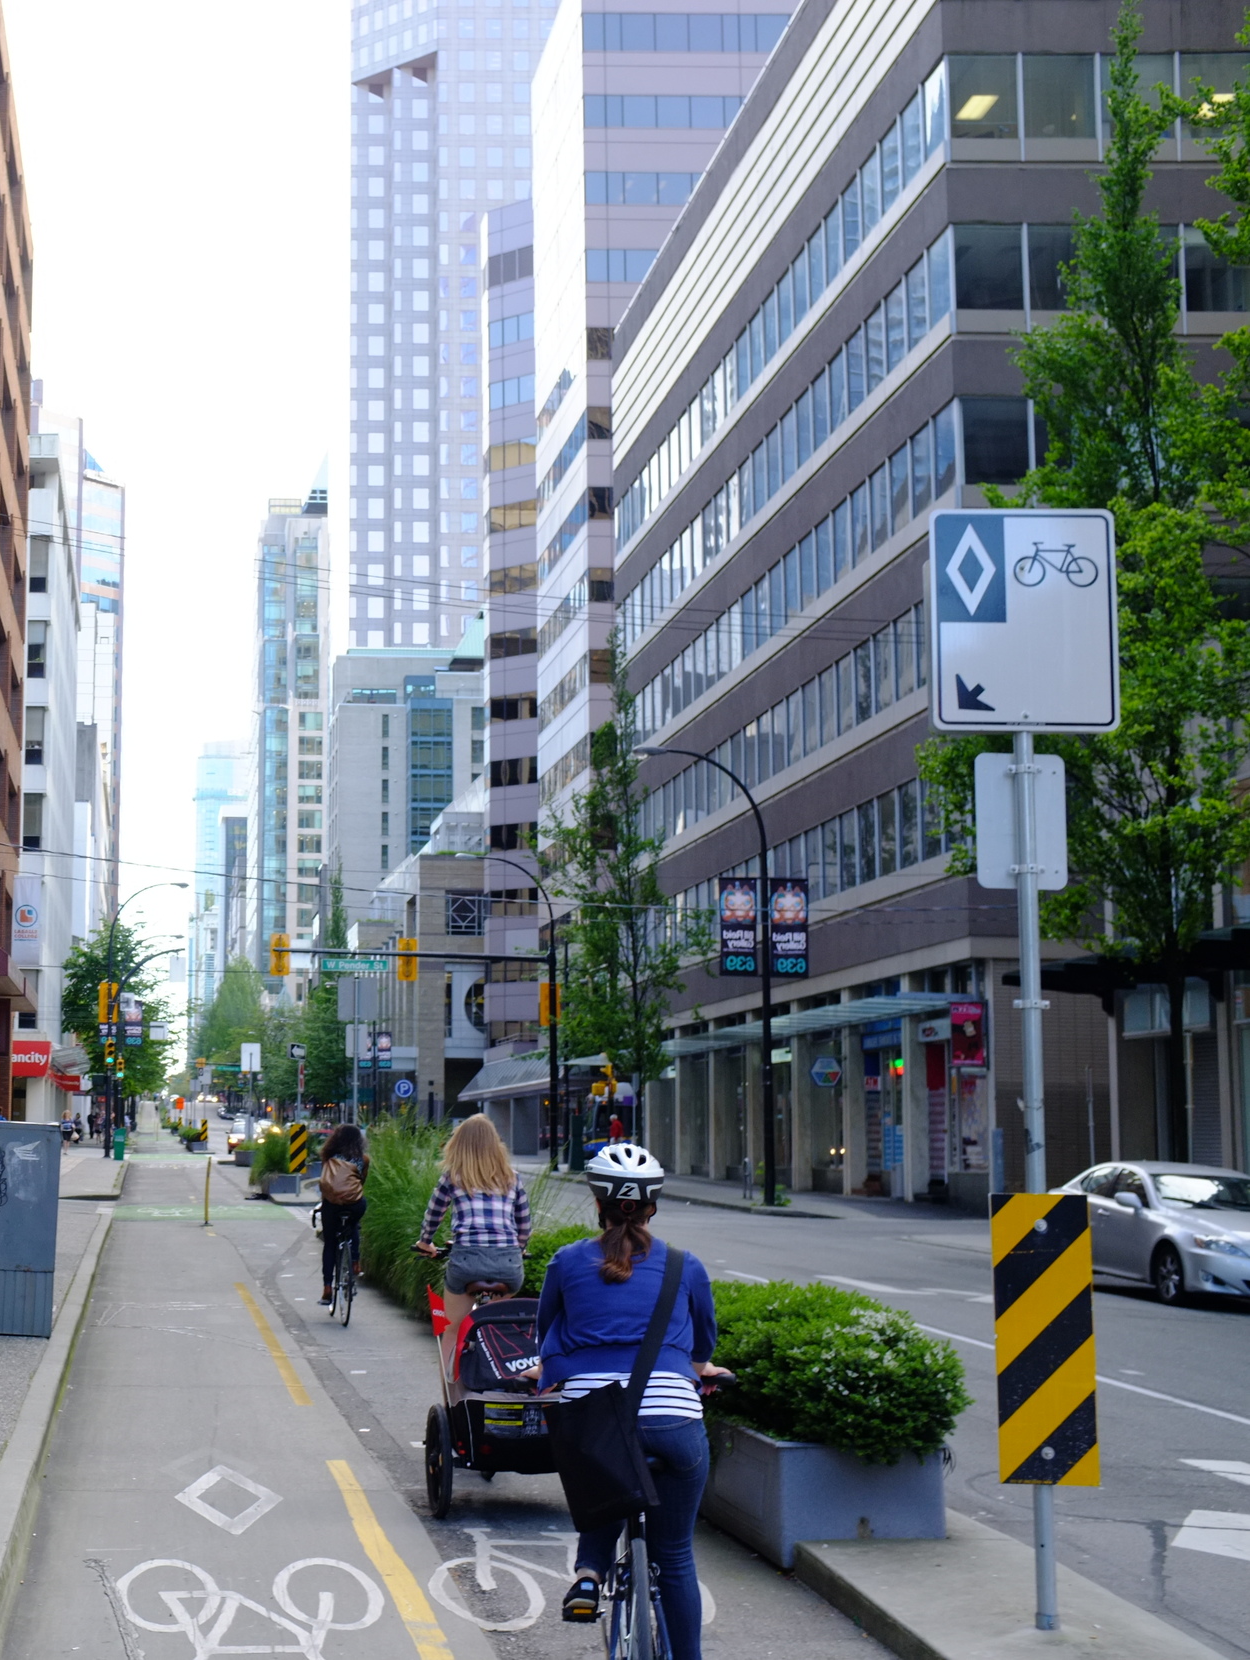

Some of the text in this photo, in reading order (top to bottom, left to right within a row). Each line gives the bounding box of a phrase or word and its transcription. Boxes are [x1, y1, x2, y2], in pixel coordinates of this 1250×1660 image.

[339, 961, 369, 969] Pender
[374, 961, 383, 969] St
[11, 1051, 48, 1066] ancity
